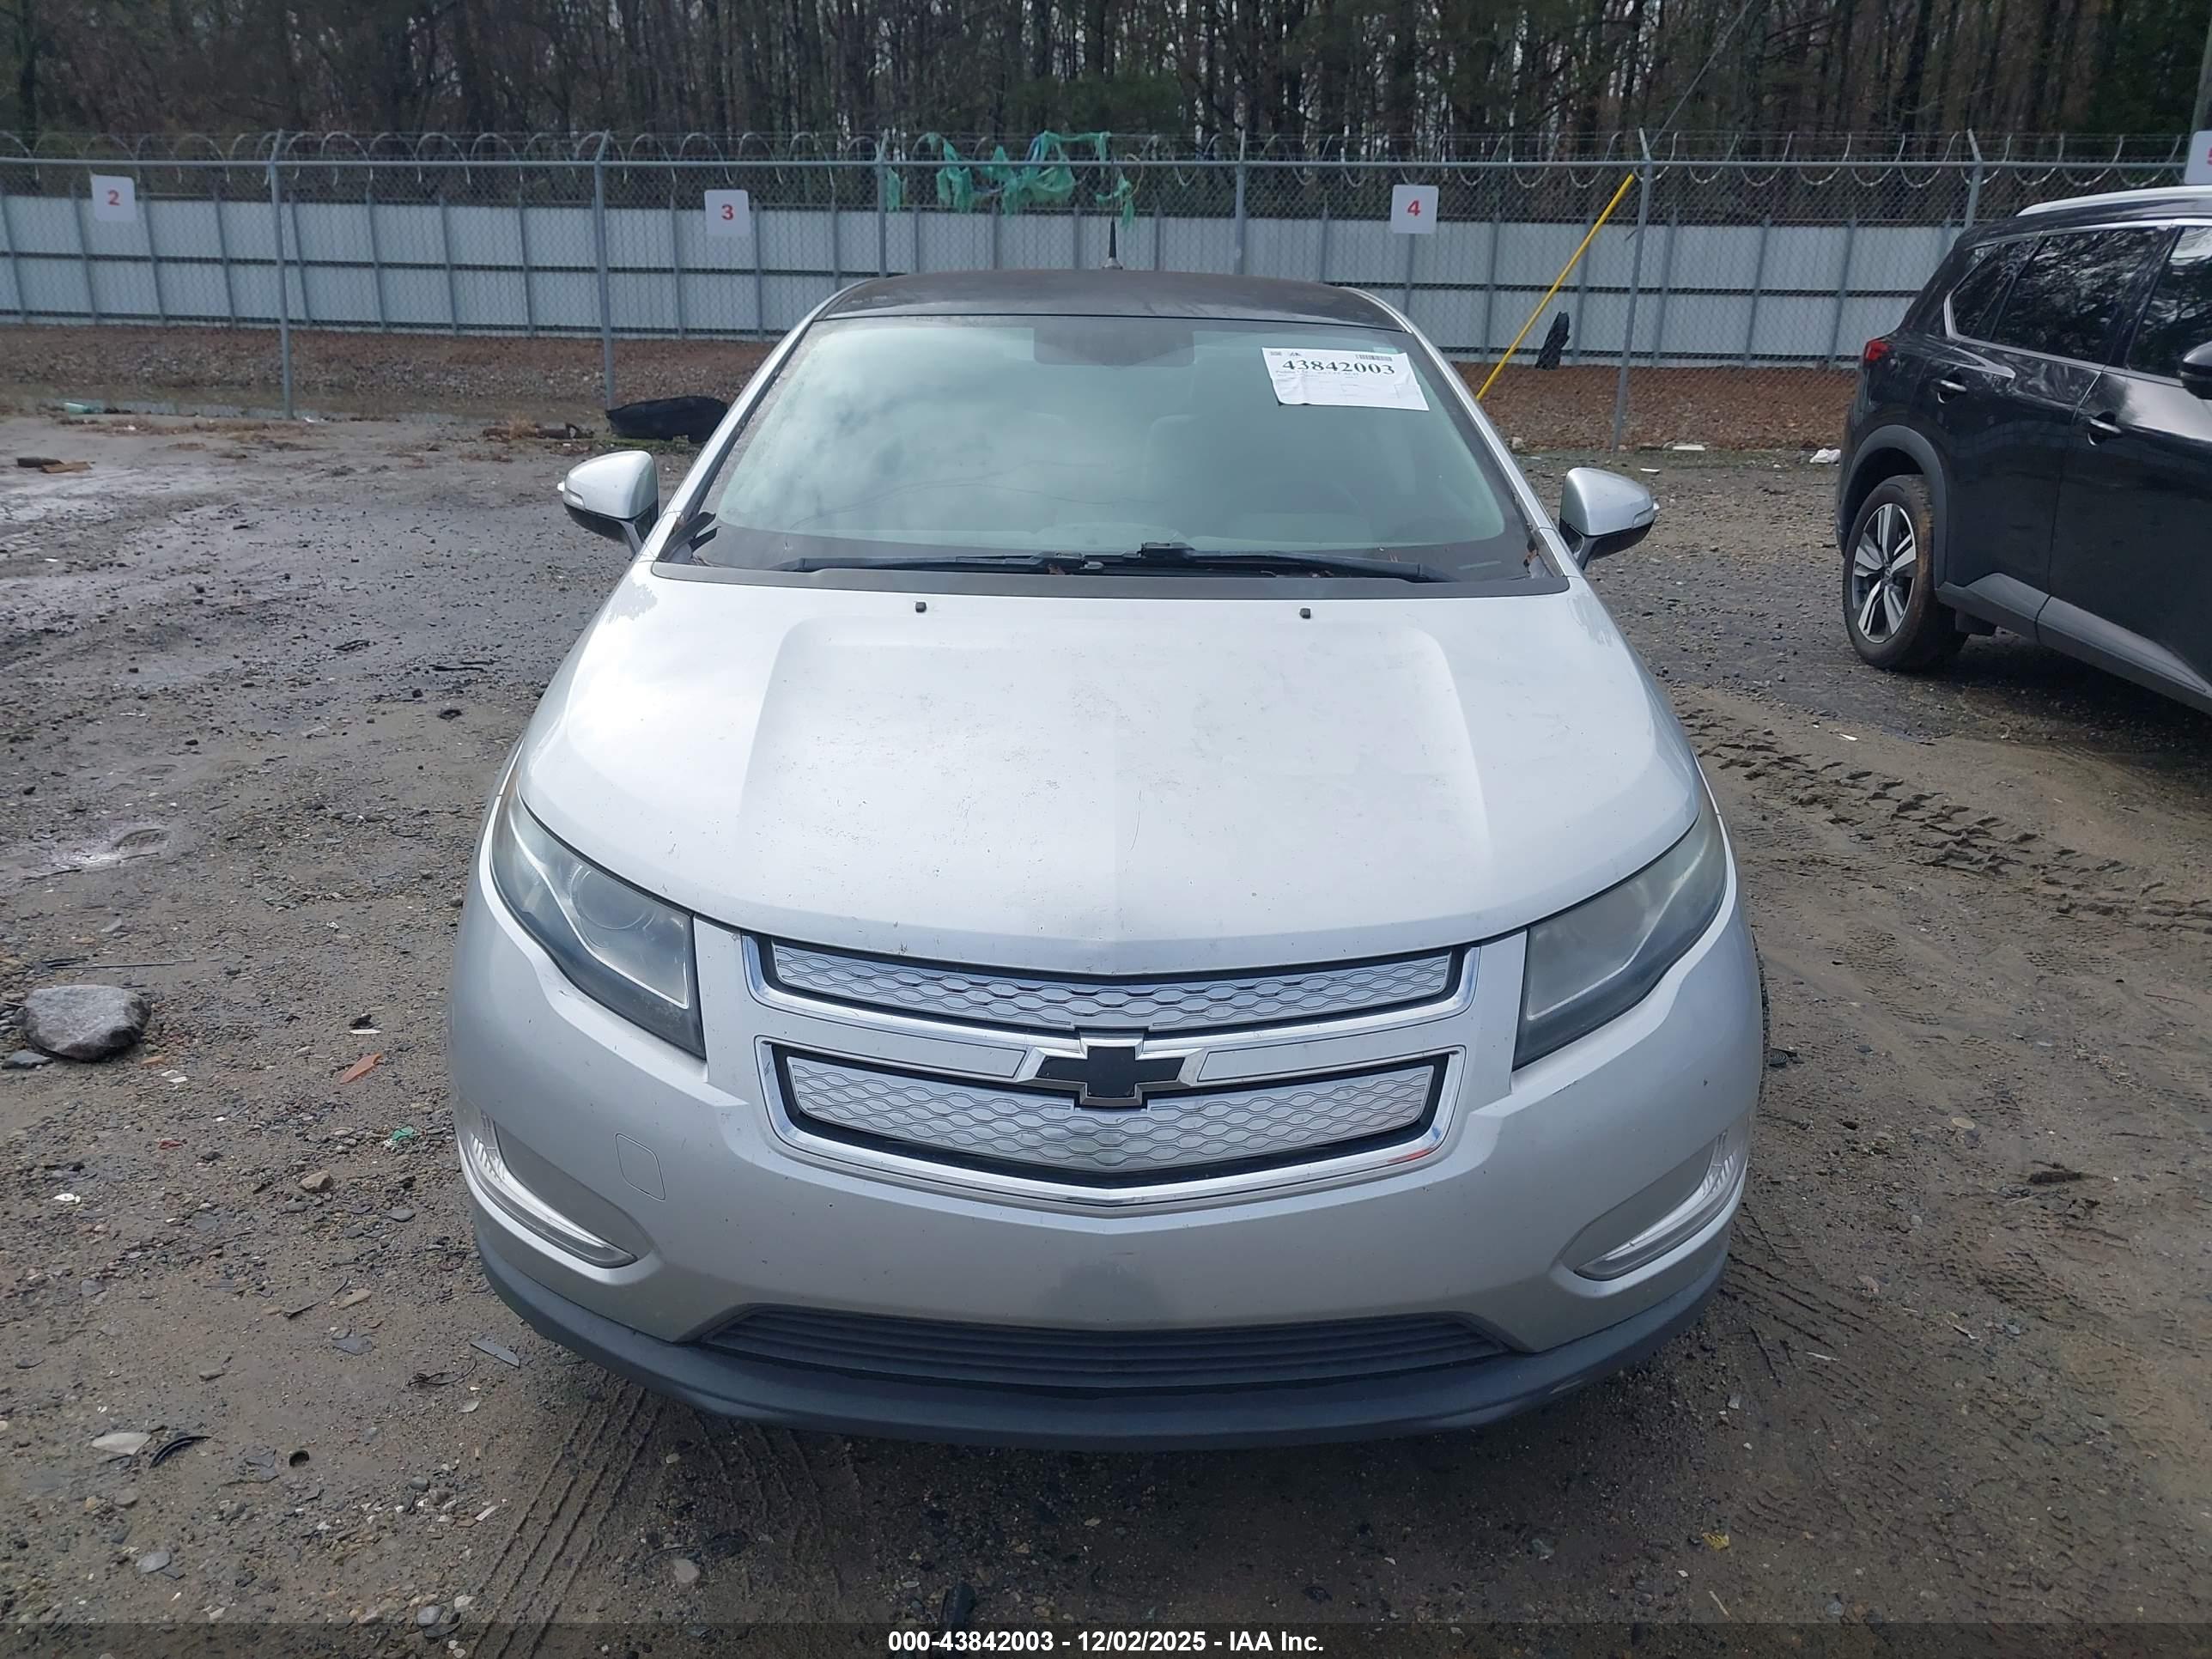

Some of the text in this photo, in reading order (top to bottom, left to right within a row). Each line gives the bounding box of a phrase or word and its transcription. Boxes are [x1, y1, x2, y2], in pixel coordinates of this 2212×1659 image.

[107, 189, 120, 206] 2
[720, 204, 734, 220] 3
[1407, 200, 1421, 216] 4
[1282, 360, 1395, 375] 43842003
